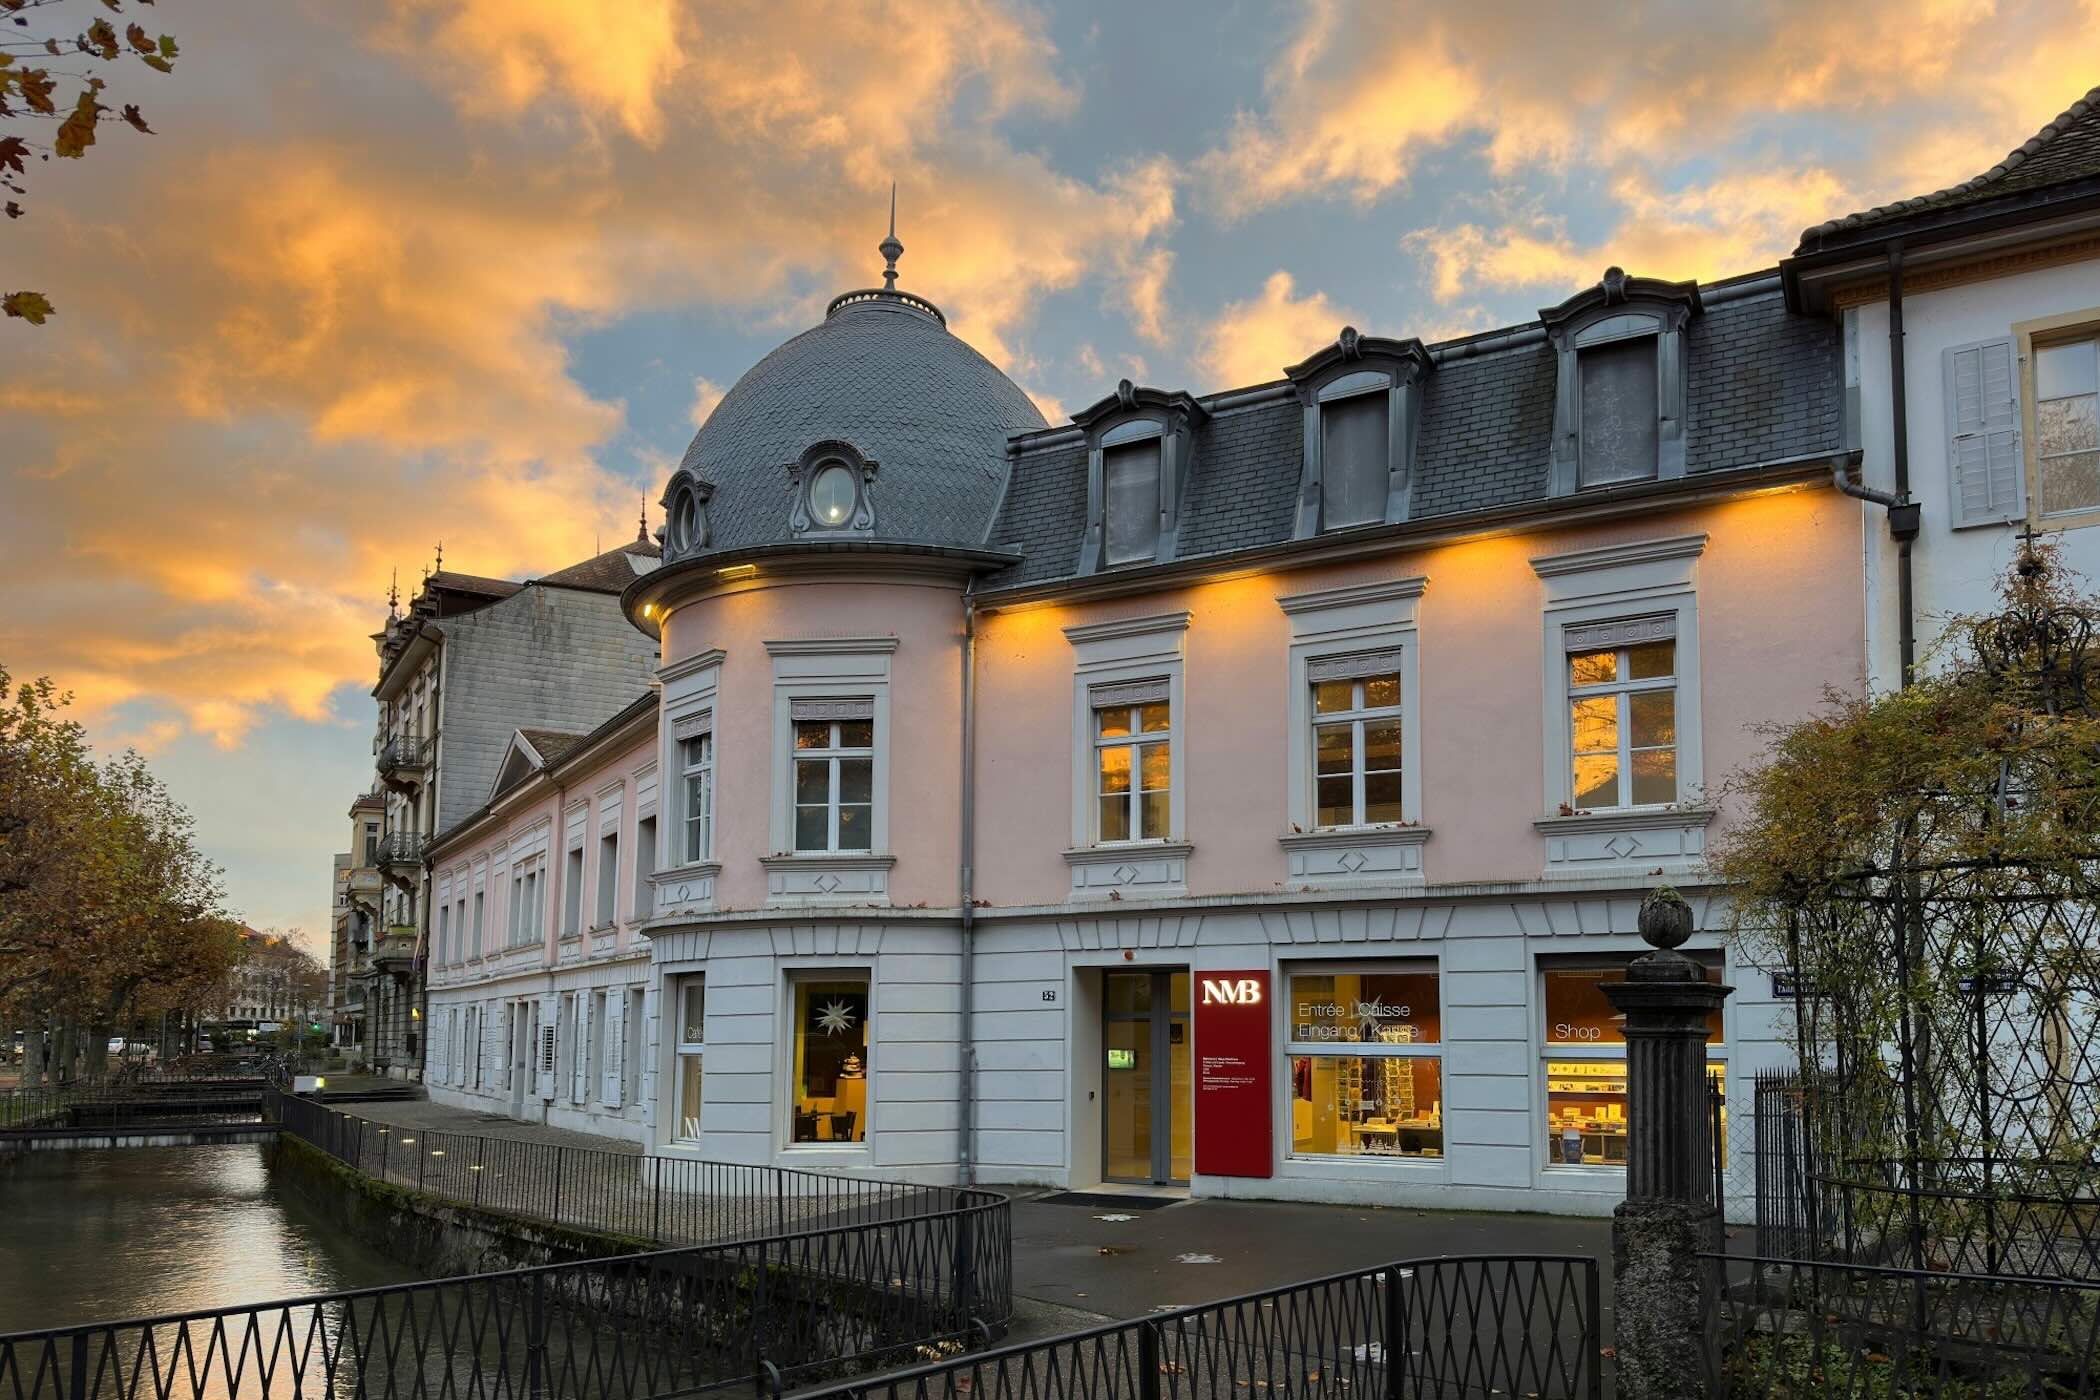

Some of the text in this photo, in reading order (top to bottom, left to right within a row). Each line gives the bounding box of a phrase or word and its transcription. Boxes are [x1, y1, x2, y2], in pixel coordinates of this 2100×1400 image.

[1202, 980, 1261, 1004] NMB
[1299, 1003, 1345, 1017] Entrée
[1358, 1002, 1410, 1017] Caisse
[1299, 1023, 1358, 1039] Eingang
[1555, 1023, 1601, 1041] Shop
